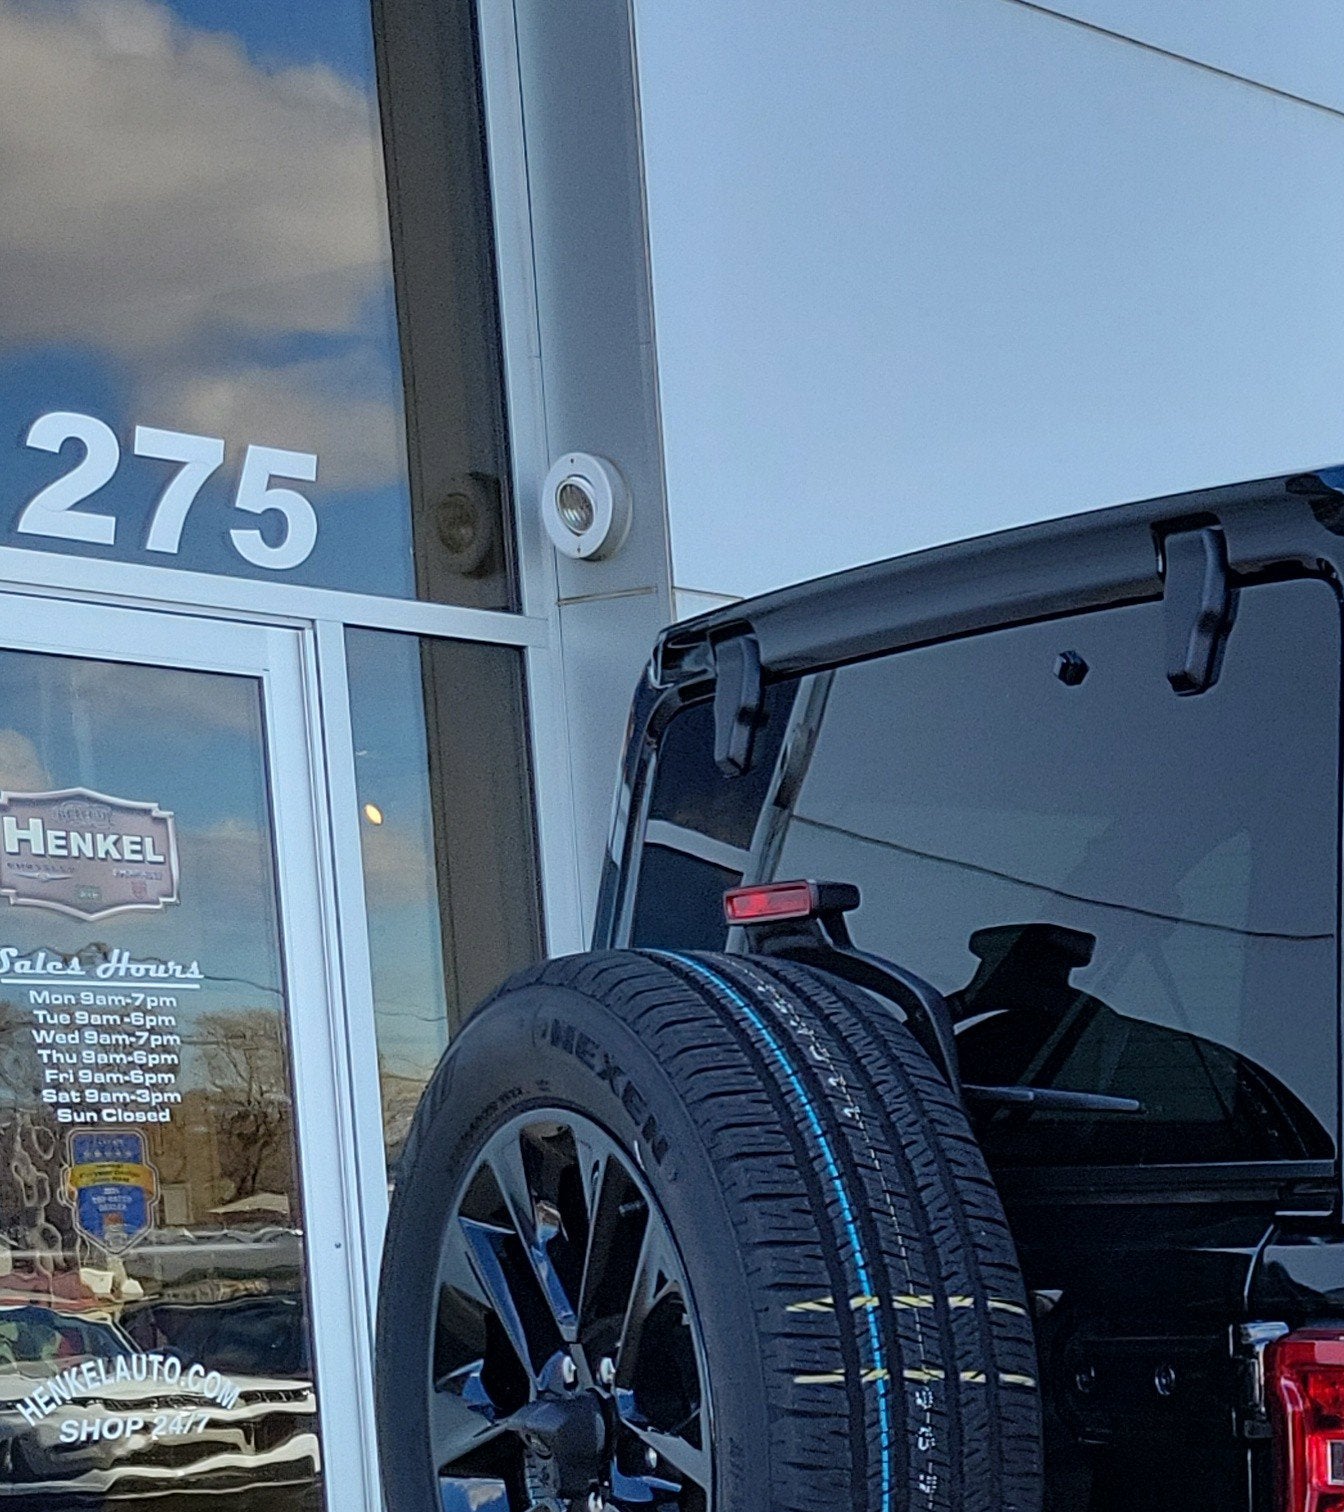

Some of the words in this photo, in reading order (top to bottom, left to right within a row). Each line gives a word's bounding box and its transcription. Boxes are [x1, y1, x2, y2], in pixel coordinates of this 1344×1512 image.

[18, 411, 318, 570] 275
[3, 816, 165, 863] HENKEL
[0, 948, 85, 975] Sales
[97, 949, 204, 979] Hours
[30, 990, 75, 1005] Mon
[80, 992, 177, 1009] 9am-7pm
[33, 1010, 70, 1024] Tue
[32, 1030, 79, 1044] Wed
[84, 1031, 180, 1047] 9am-7pm
[38, 1050, 76, 1064] Thu
[83, 1051, 178, 1067] 9am-6pm
[45, 1070, 74, 1083] Fri
[78, 1070, 175, 1087] 9am-6pm
[42, 1089, 80, 1103] Sat
[85, 1090, 181, 1106] 9am-3pm
[551, 1018, 668, 1166] NEXEN
[57, 1109, 97, 1122] Sun
[102, 1109, 171, 1122] Closed
[16, 1353, 241, 1427] HENKELAUTO.COM
[59, 1416, 144, 1443] SHOP
[152, 1414, 210, 1436] 24/7
